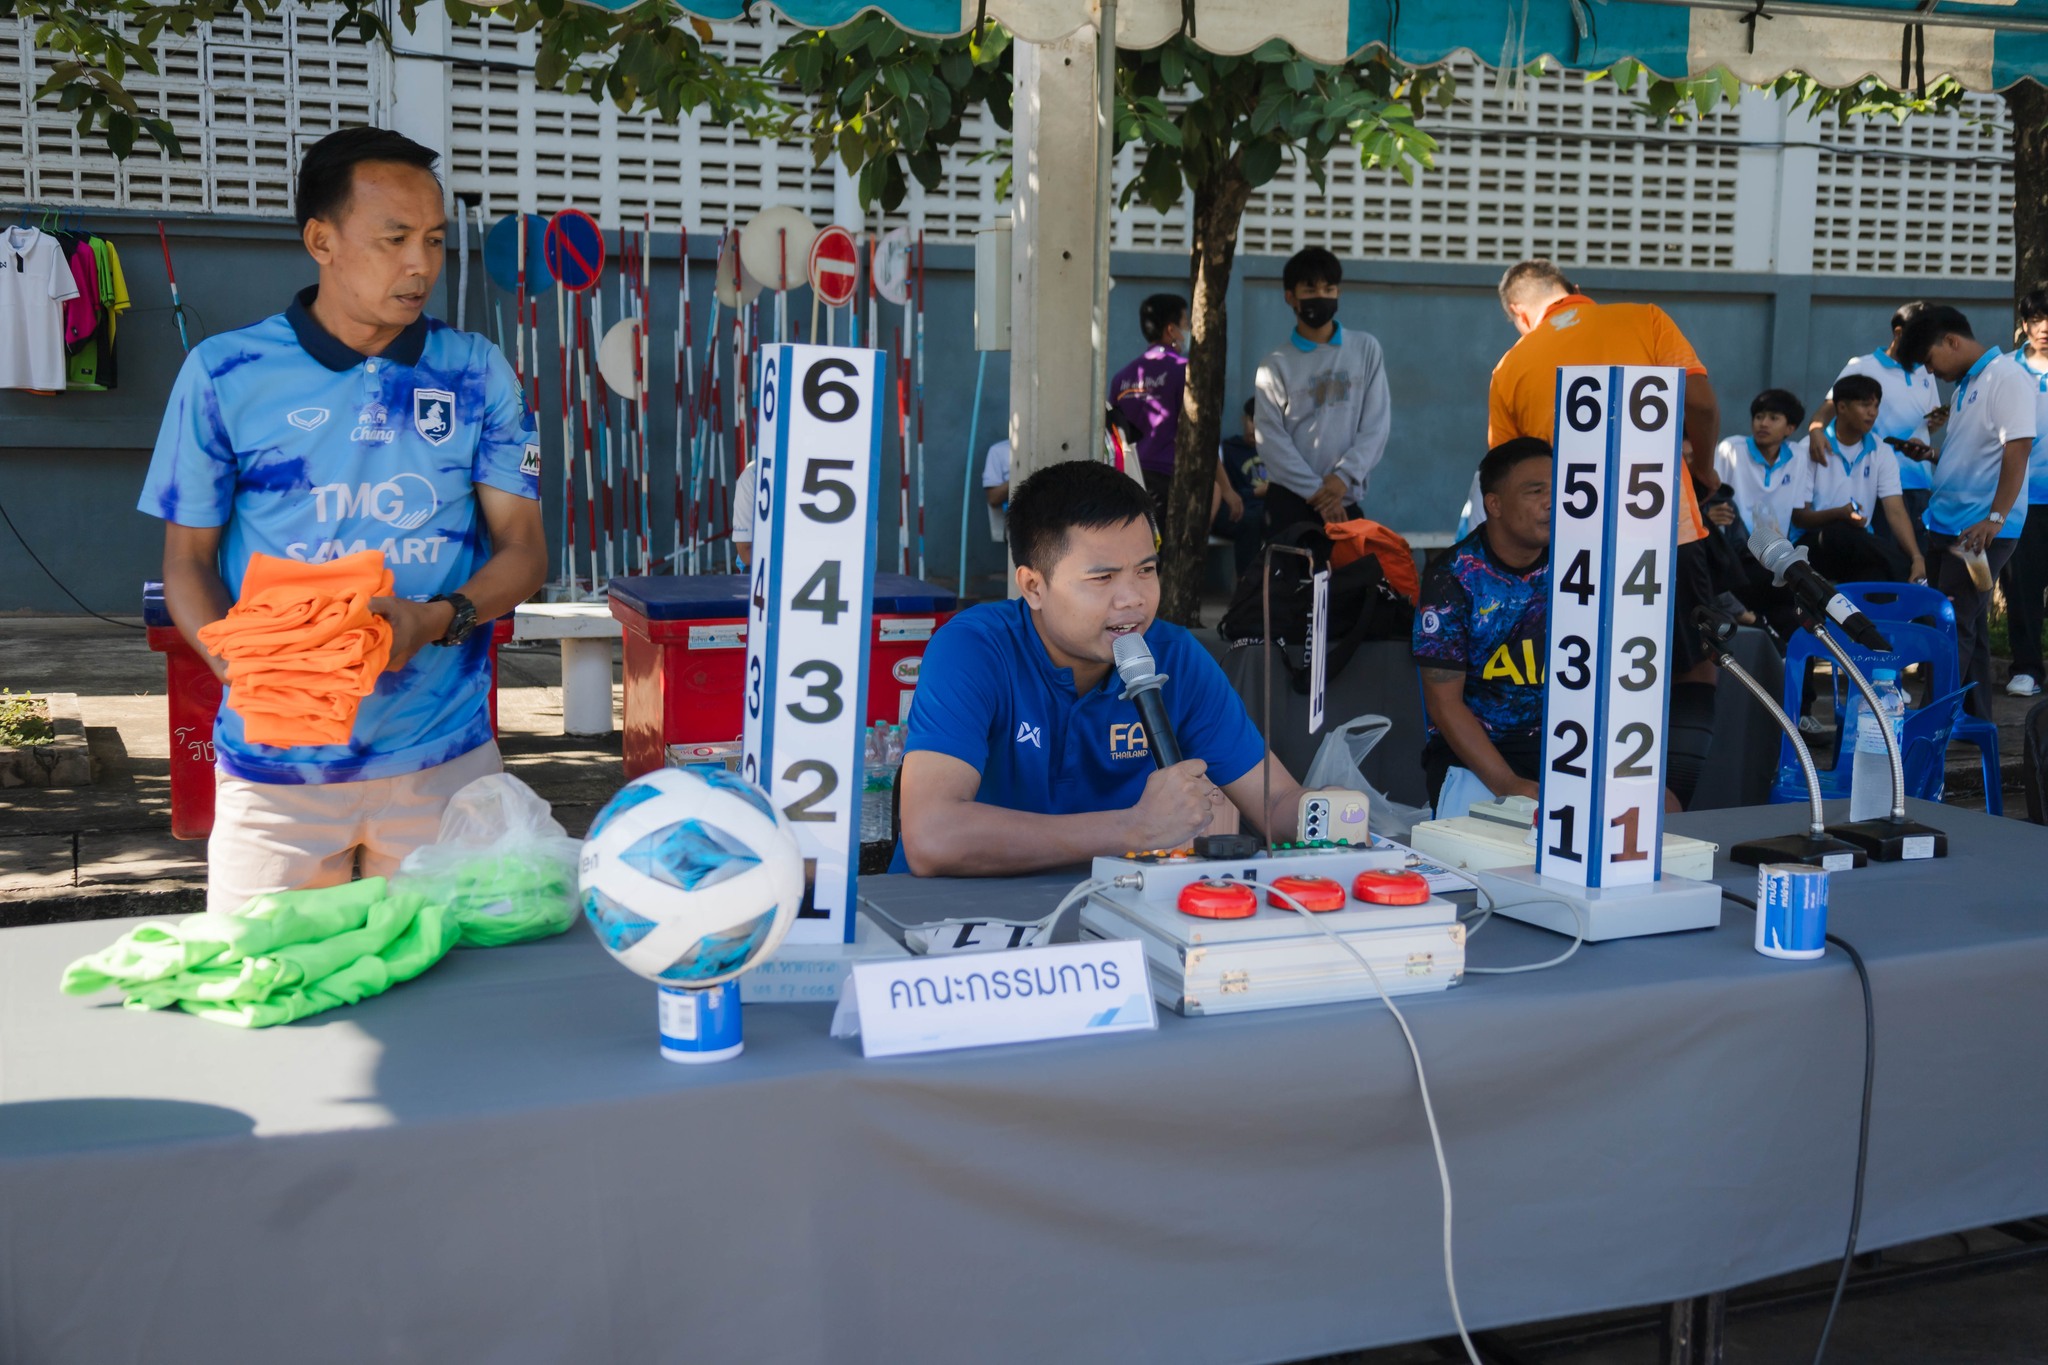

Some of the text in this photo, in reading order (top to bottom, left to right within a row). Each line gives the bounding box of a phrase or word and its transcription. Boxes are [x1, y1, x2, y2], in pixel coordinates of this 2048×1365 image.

[763, 358, 776, 422] 6
[802, 358, 859, 422] 6
[1566, 376, 1601, 432] 6
[1628, 375, 1669, 432] 6
[351, 425, 396, 444] Chang
[309, 482, 404, 523] TMG
[758, 457, 771, 522] 5
[798, 458, 856, 524] 5
[1562, 463, 1598, 519] 5
[1625, 463, 1665, 520] 5
[753, 557, 765, 622] 4
[791, 560, 849, 624] 4
[1560, 549, 1595, 606] 4
[1622, 549, 1662, 606] 4
[749, 655, 761, 719] 3
[1482, 639, 1546, 686] AI
[1556, 635, 1591, 691] 3
[1618, 636, 1658, 692] 3
[786, 659, 844, 724] 3
[1110, 721, 1149, 752] FA
[1110, 749, 1149, 760] THAILAND
[1552, 720, 1589, 778] 2
[1613, 722, 1655, 778] 2
[781, 759, 839, 822] 2
[1548, 805, 1583, 863] 1
[1610, 806, 1648, 863] 1
[889, 960, 1121, 1010] คณะกรรมการ
